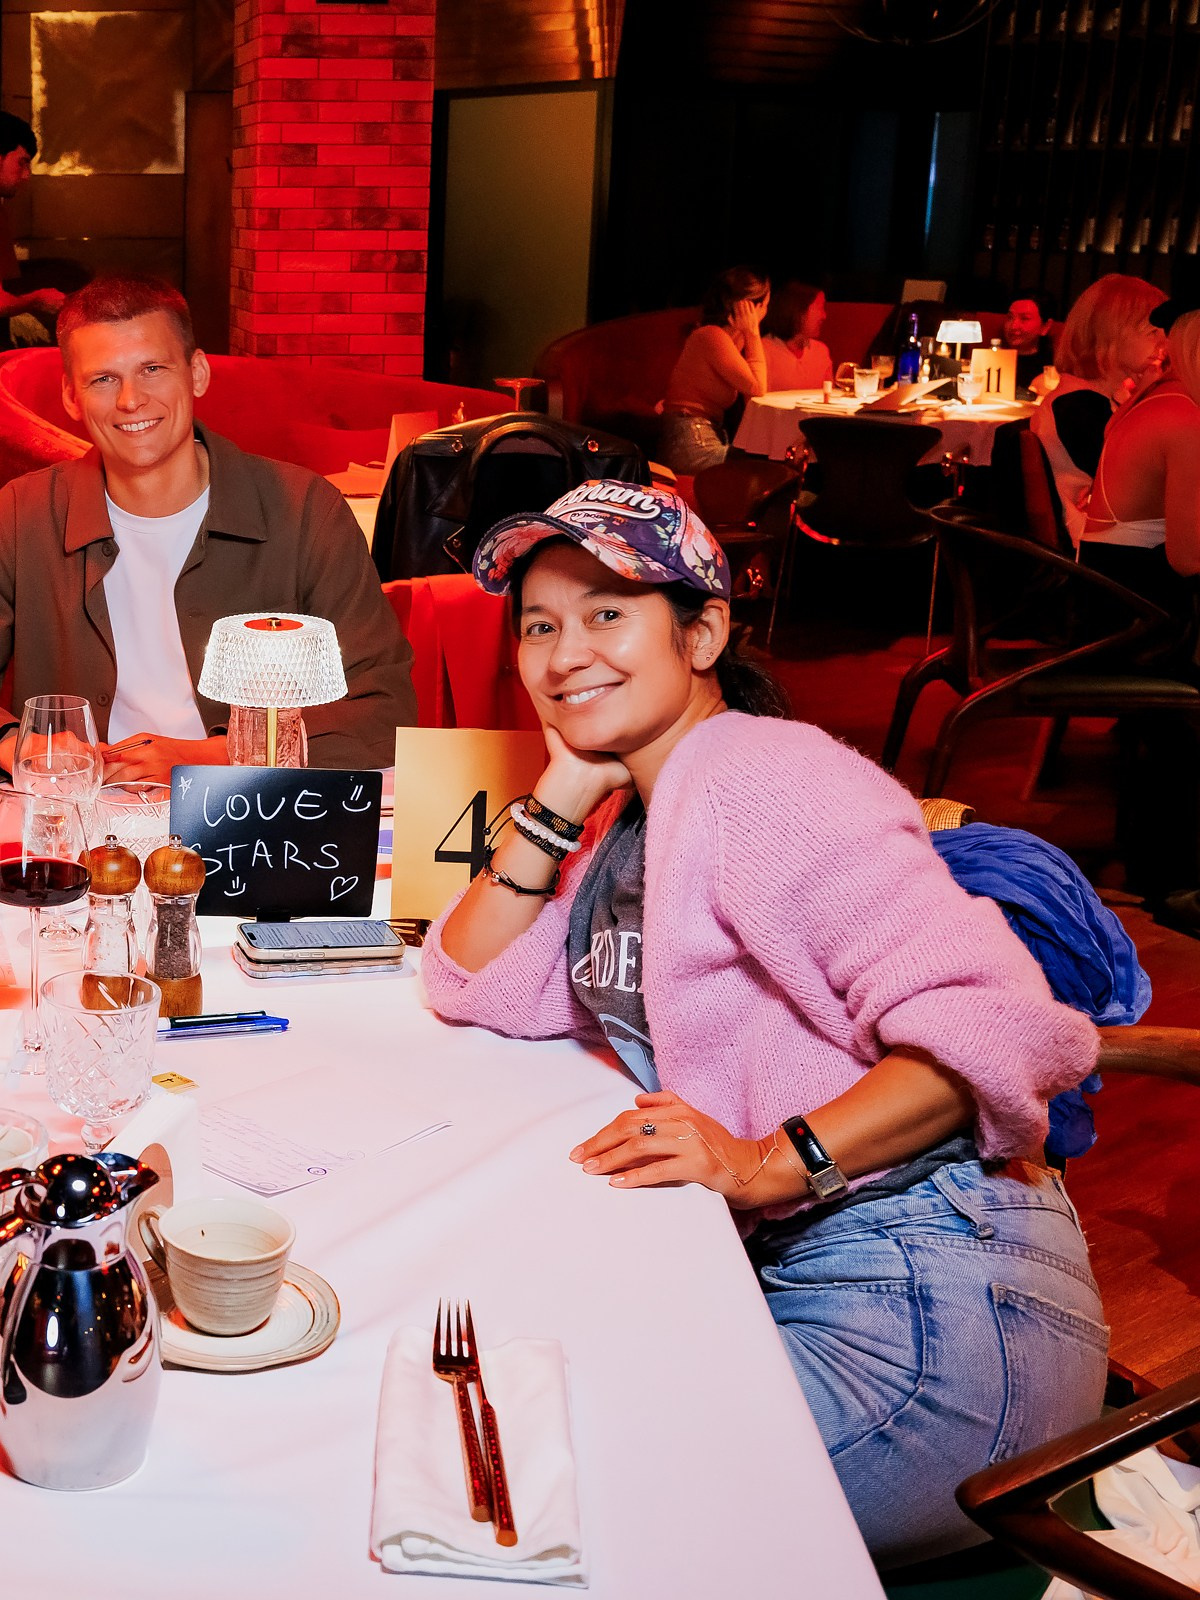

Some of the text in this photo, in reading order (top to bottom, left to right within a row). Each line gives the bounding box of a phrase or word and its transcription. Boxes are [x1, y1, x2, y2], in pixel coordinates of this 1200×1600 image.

[984, 366, 1002, 393] 11
[203, 786, 328, 828] LOVE
[434, 790, 488, 884] 4
[190, 839, 340, 876] STARS
